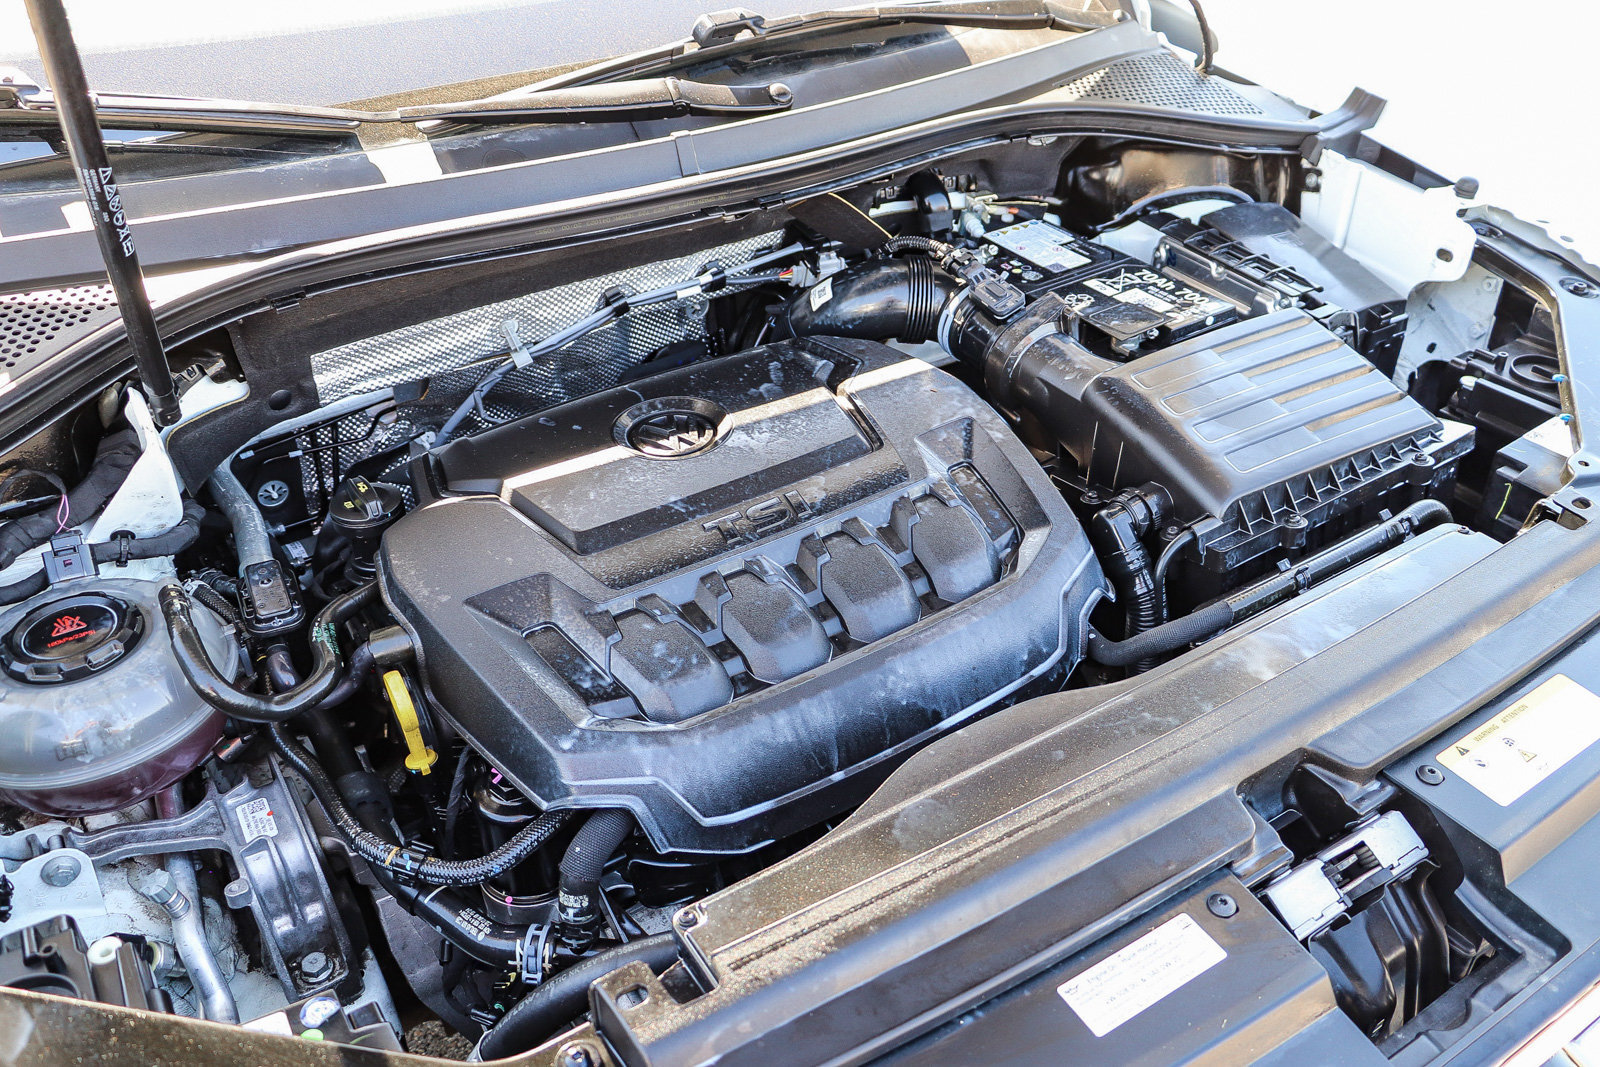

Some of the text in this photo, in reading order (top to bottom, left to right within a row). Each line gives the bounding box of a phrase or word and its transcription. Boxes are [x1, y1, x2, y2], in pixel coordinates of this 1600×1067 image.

[1134, 268, 1176, 291] 70Ah
[702, 489, 813, 545] TSI
[1473, 703, 1528, 742] WARNING ATTENTION
